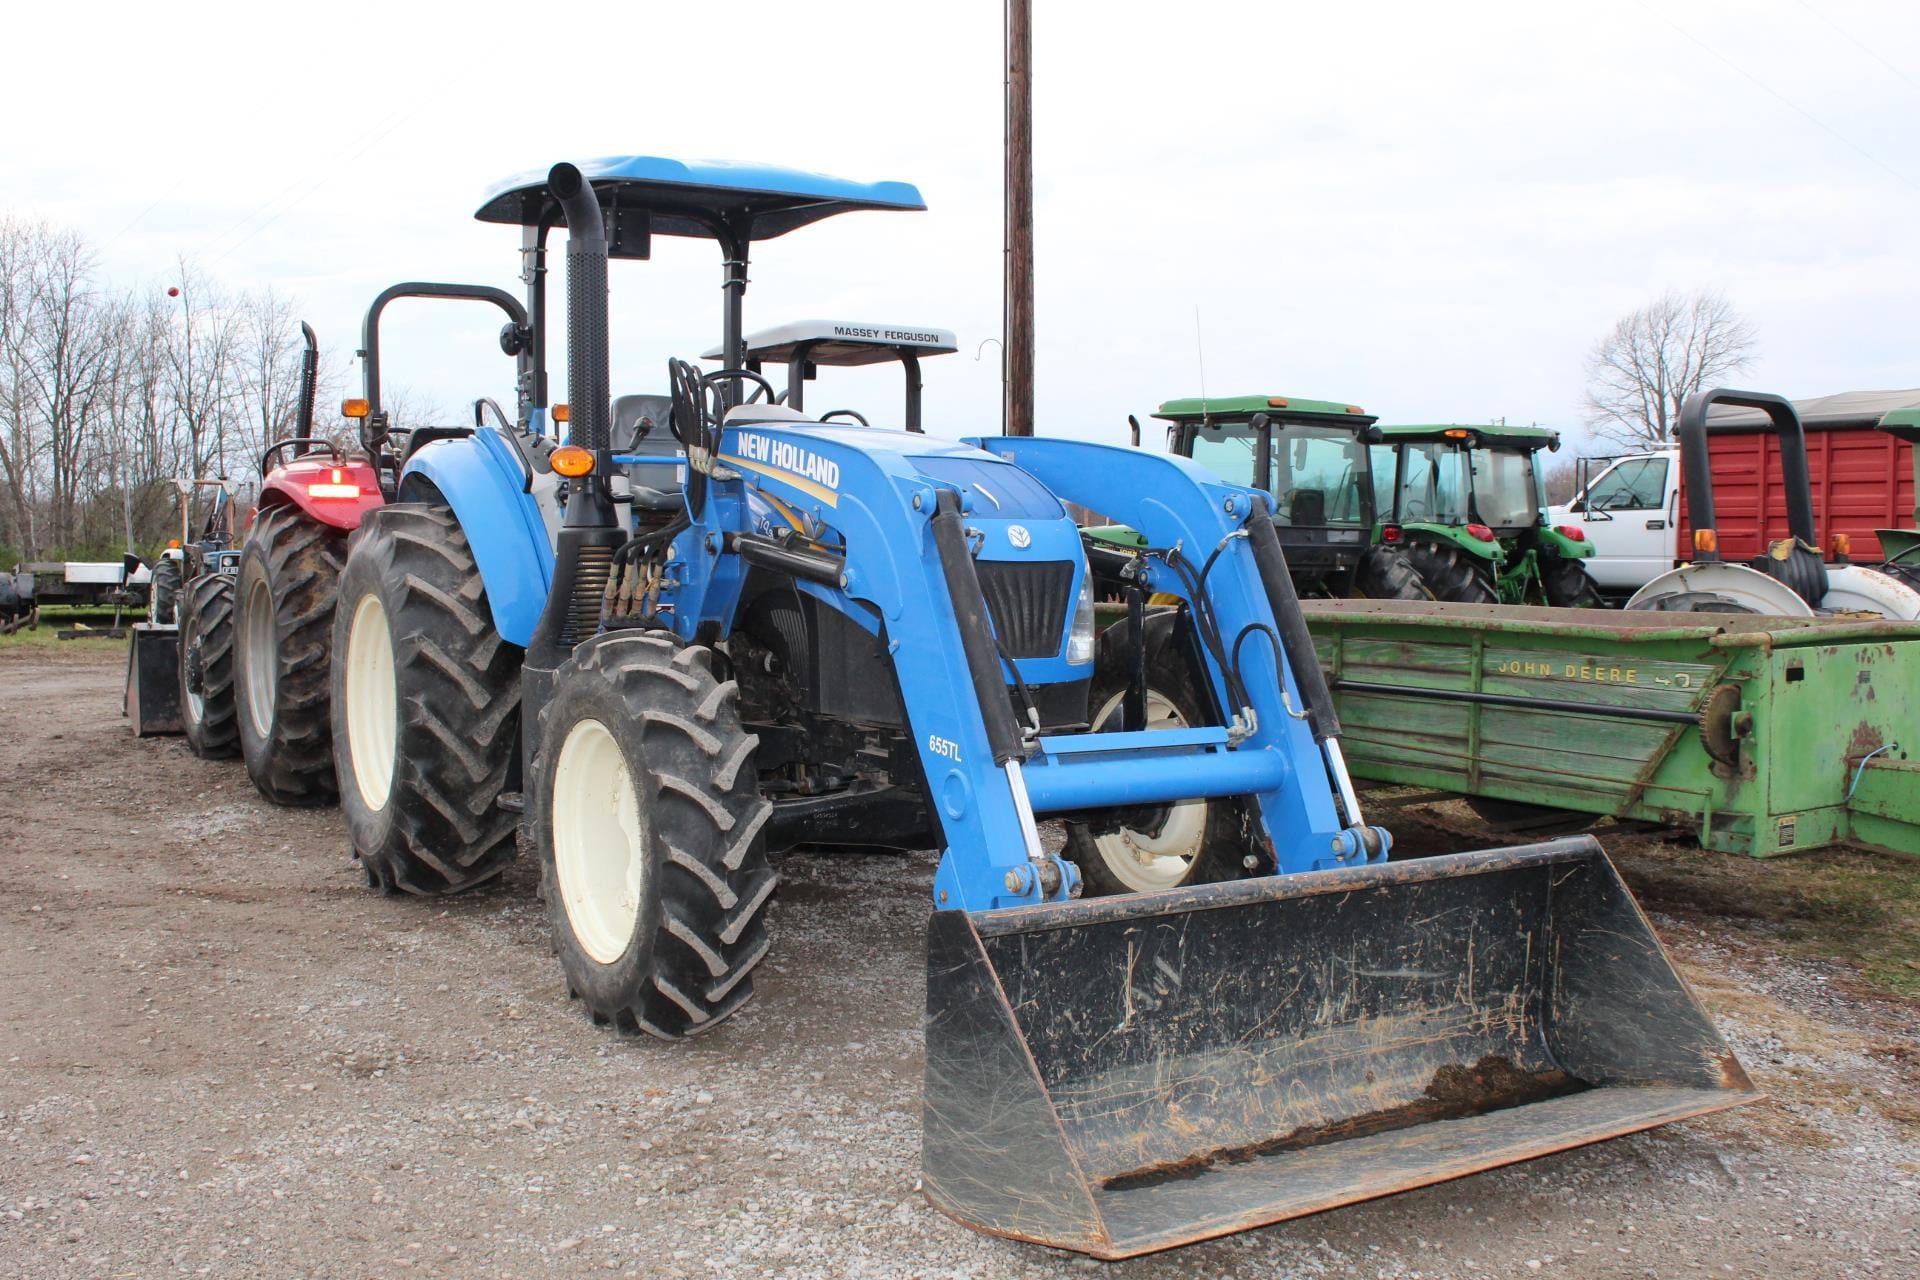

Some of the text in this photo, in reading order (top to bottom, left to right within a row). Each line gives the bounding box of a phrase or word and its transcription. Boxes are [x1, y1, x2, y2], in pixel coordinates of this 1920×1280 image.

[834, 326, 939, 343] MASSEY FERGUSON
[738, 431, 840, 490] NEW HOLLAND
[1498, 660, 1550, 676] JOHN
[1565, 664, 1637, 683] DEERE
[929, 734, 962, 763] 655TL
